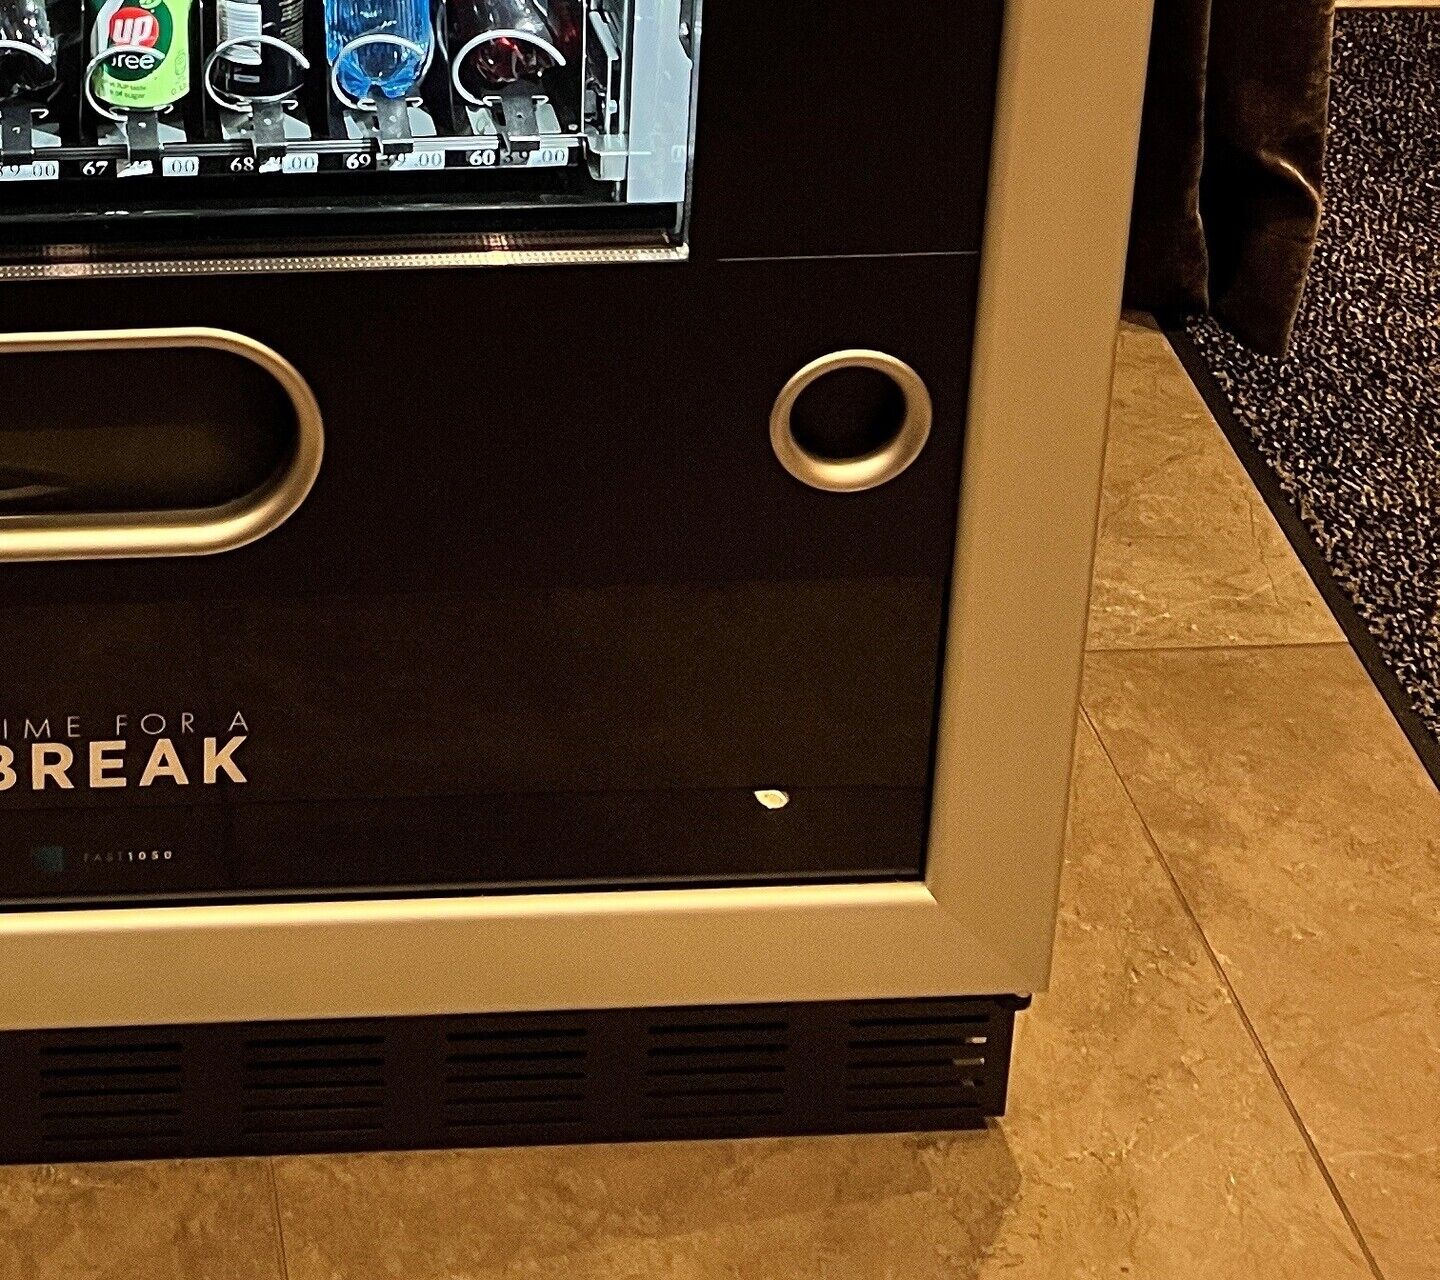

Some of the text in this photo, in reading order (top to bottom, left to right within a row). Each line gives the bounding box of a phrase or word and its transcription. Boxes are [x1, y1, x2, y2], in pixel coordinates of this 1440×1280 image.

[111, 53, 156, 70] ree
[230, 156, 255, 173] 68
[346, 153, 372, 170] 69
[469, 150, 496, 167] 60
[82, 161, 109, 177] 67
[116, 712, 195, 736] FOR
[227, 710, 249, 732] A
